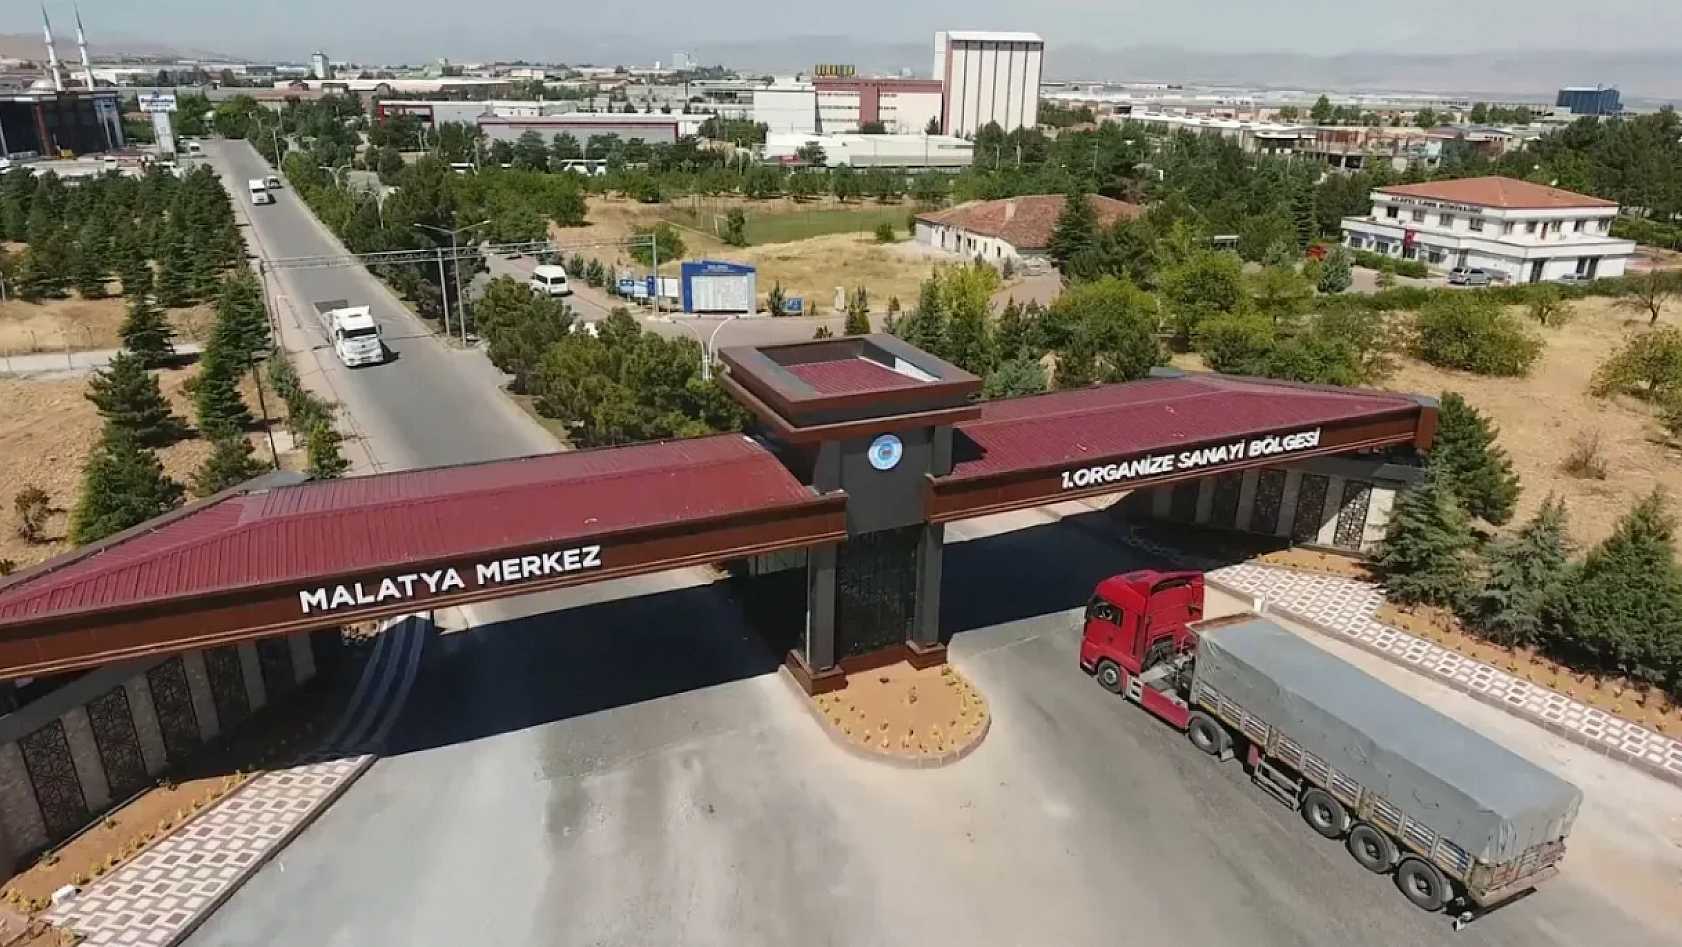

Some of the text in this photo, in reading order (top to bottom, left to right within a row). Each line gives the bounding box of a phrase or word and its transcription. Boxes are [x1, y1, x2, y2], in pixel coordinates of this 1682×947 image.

[1061, 428, 1320, 488] 1.ORGANİZE SANAYİ BÖLGESİ
[300, 545, 602, 613] MALATYA MERKEZ
